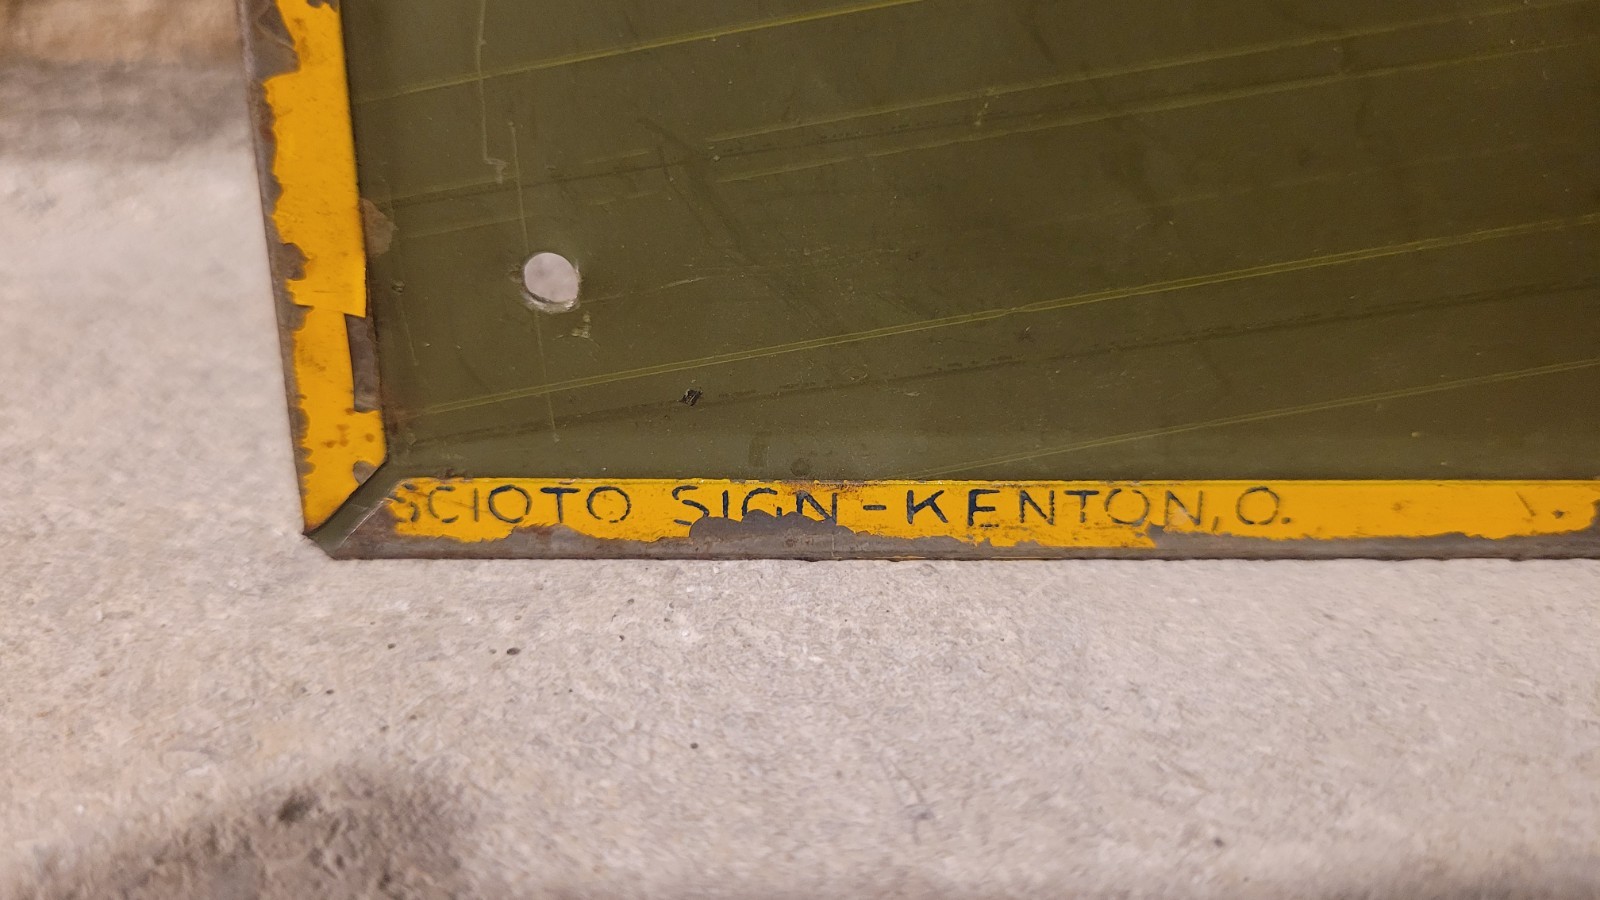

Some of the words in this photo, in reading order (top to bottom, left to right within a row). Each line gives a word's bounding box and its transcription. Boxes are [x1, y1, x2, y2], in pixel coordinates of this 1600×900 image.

[393, 484, 632, 524] SCIOTO
[671, 485, 838, 526] SIGN
[1235, 486, 1291, 525] O.
